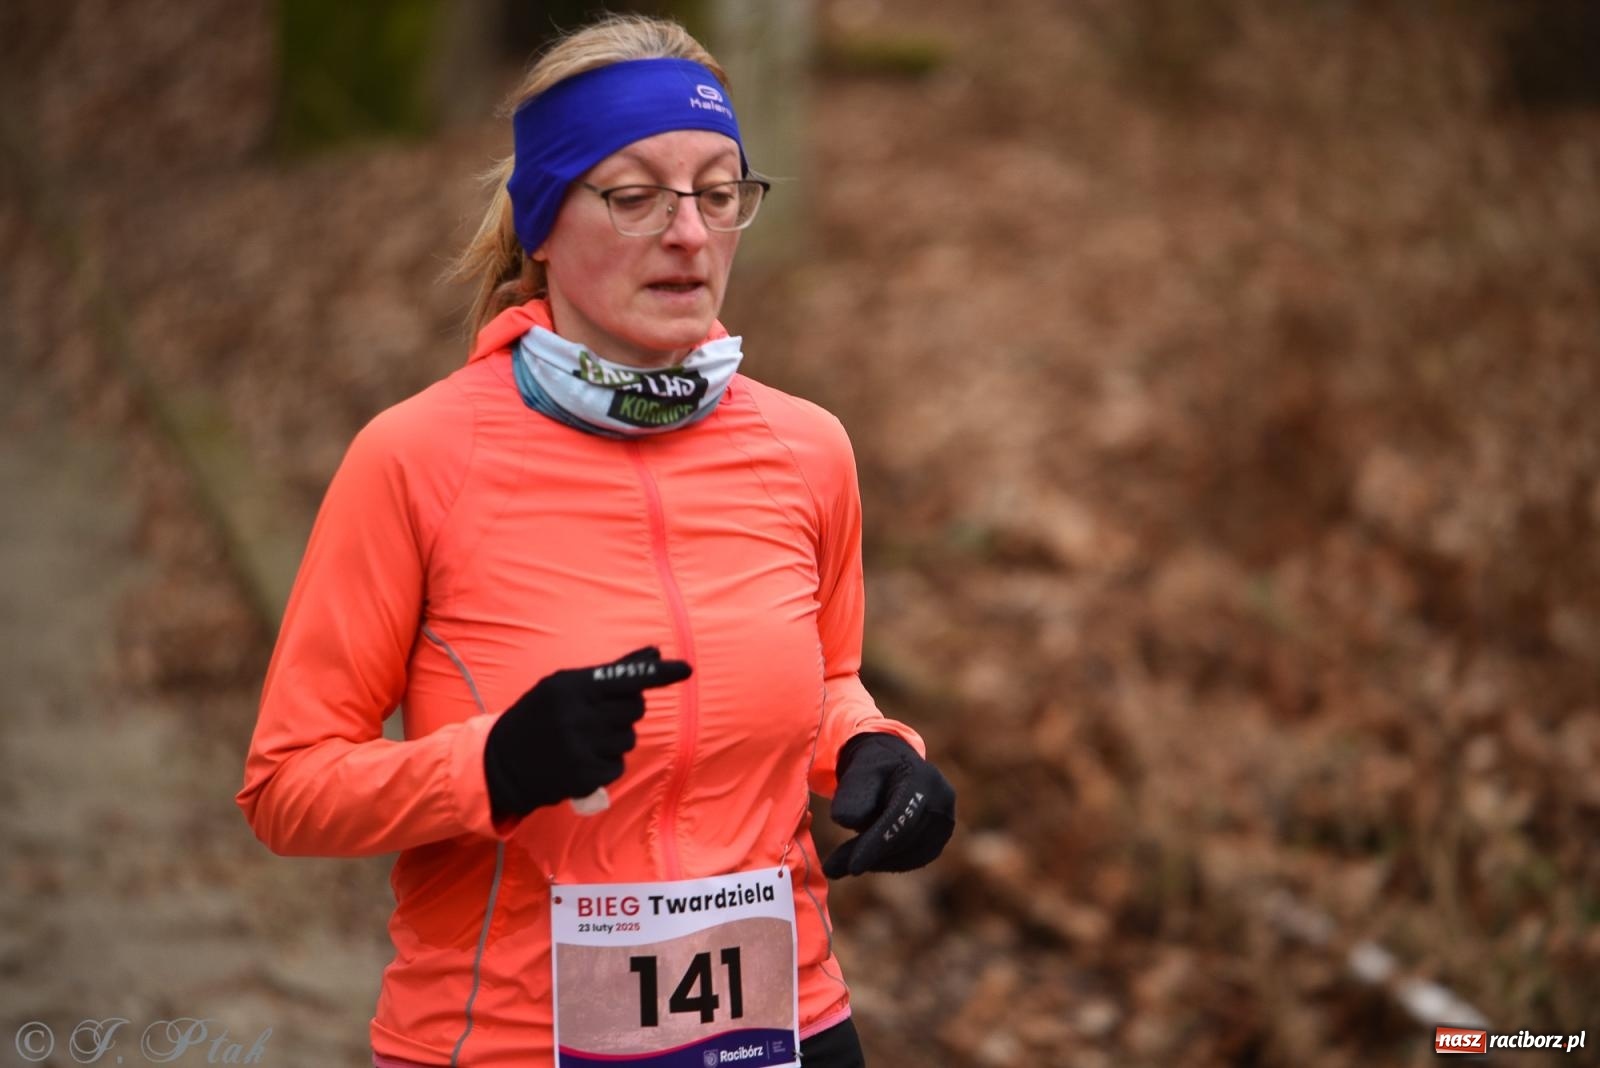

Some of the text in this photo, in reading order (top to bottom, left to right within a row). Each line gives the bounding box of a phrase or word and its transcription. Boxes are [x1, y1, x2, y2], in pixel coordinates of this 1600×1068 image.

[593, 661, 656, 680] KIPSTA
[883, 791, 925, 842] KIPSTA
[577, 883, 775, 918] BIEG Twardziela
[578, 922, 641, 934] 23 luty 2025
[629, 946, 744, 1028] 141
[720, 1044, 764, 1063] Racibórz
